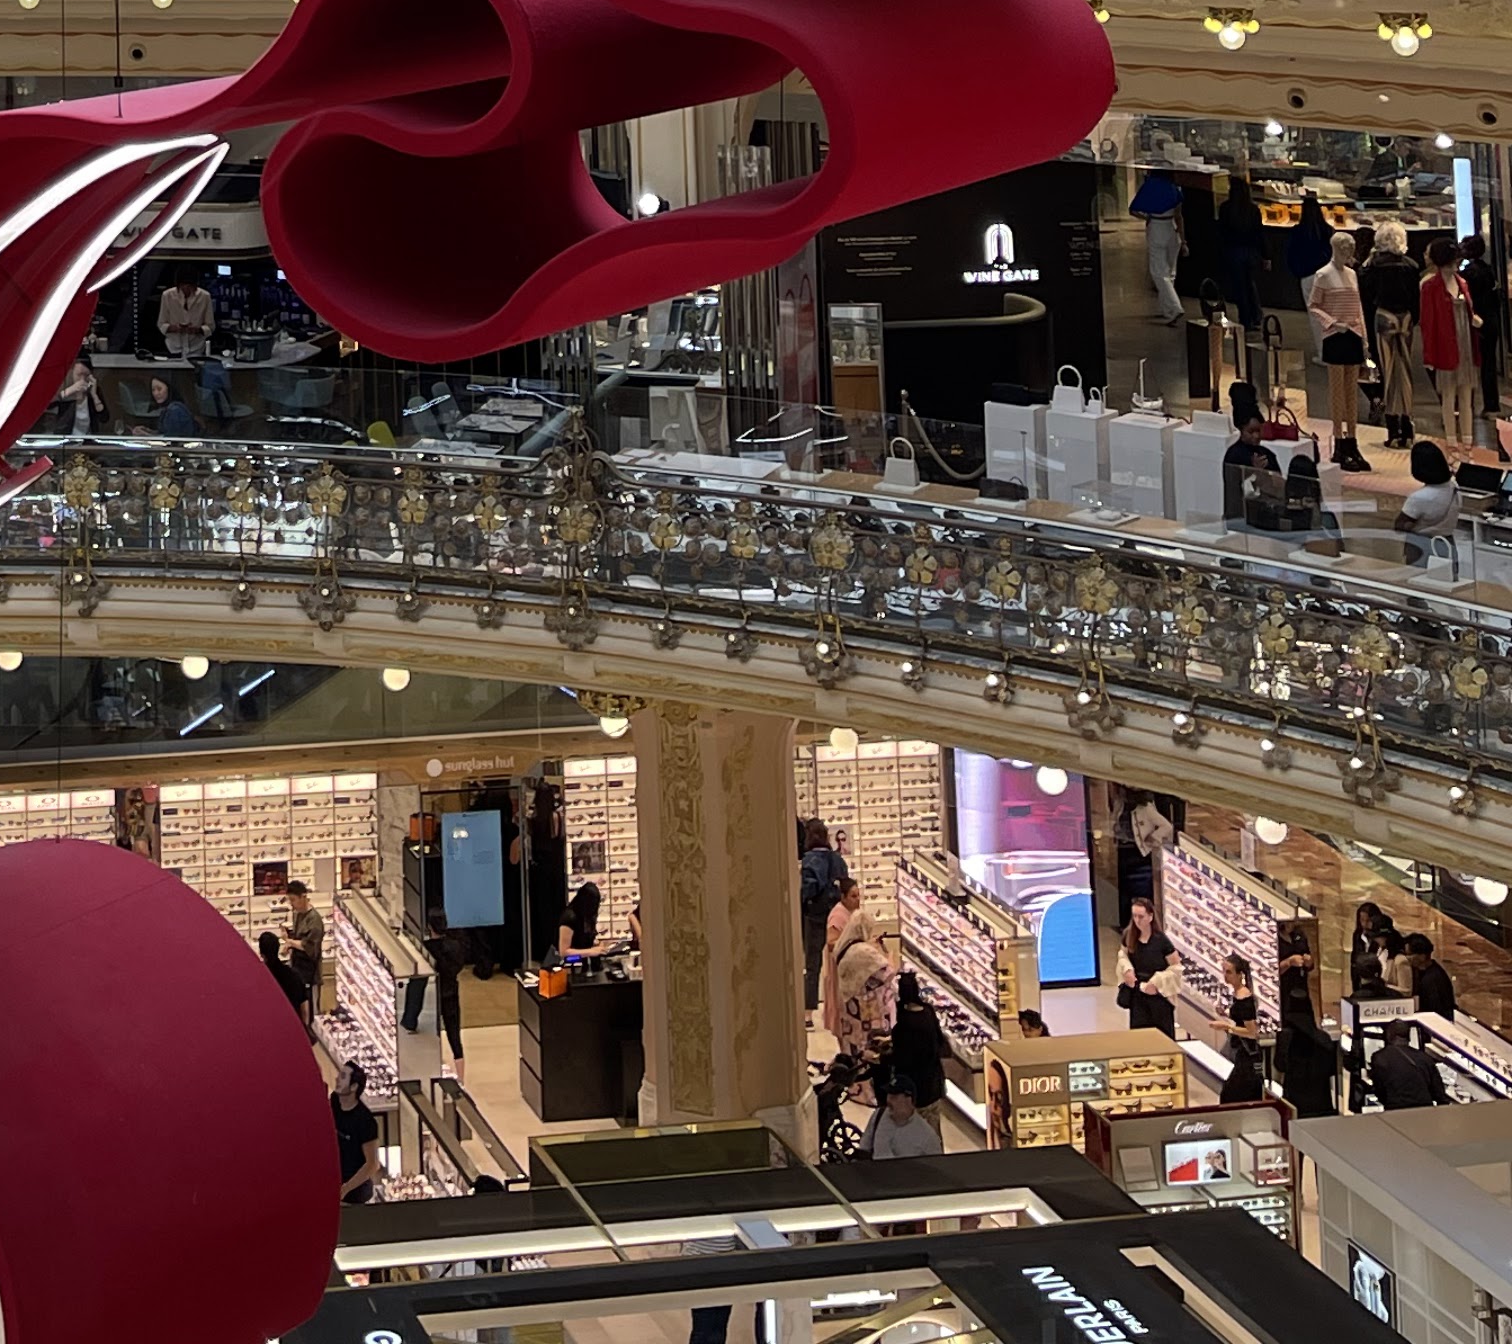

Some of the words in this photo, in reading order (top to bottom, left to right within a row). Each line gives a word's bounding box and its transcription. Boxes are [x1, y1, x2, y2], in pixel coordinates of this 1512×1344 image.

[171, 226, 223, 241] GATE
[962, 269, 1001, 284] WINE
[1002, 268, 1040, 282] GATE
[444, 756, 494, 774] sunglass
[495, 755, 516, 770] hut
[1363, 1005, 1409, 1017] CHANEL
[1018, 1075, 1062, 1096] DIOR
[1174, 1119, 1215, 1135] Cartier
